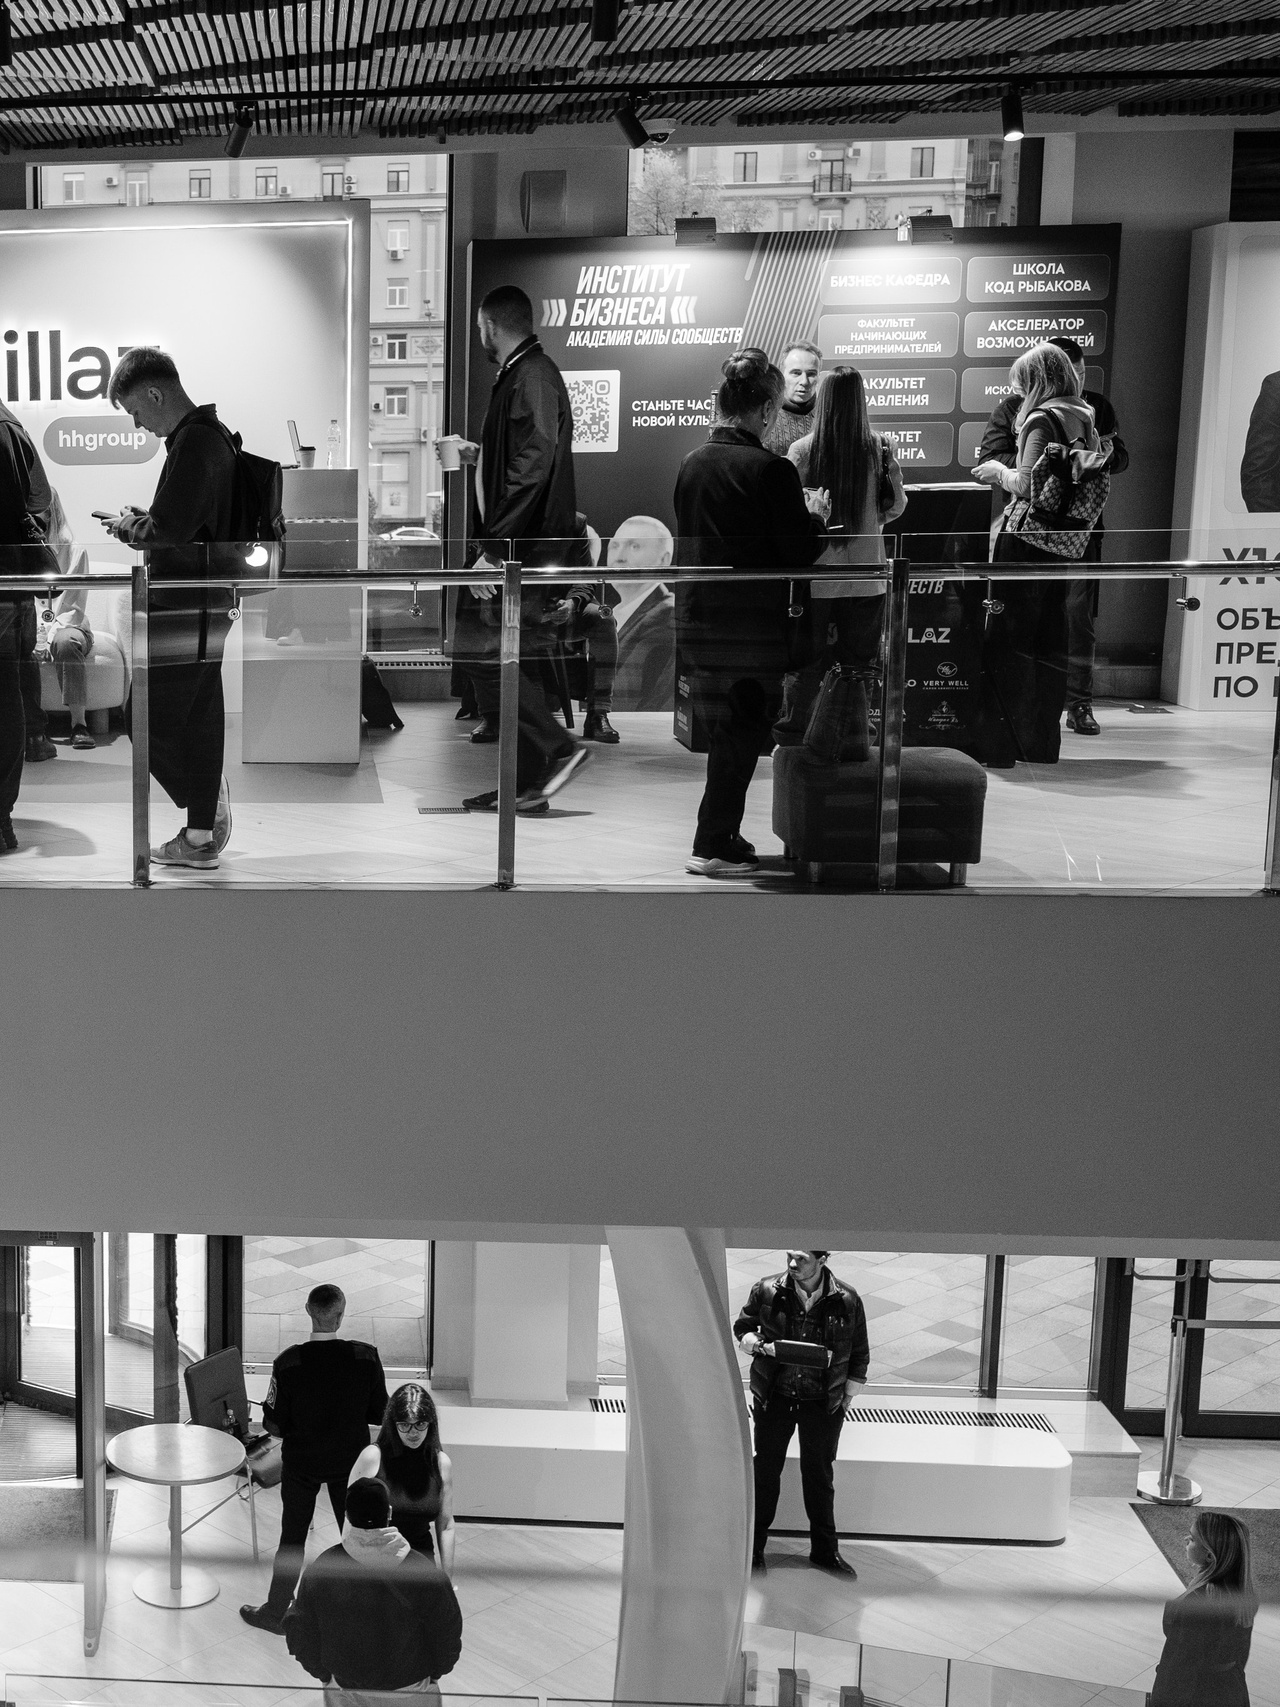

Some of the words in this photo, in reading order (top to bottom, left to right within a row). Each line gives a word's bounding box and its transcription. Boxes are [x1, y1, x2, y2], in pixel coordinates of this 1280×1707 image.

[1012, 263, 1065, 275] ШКОЛА
[576, 264, 690, 294] ИНСТИТУТ
[830, 275, 882, 287] БИЗНЕС
[885, 273, 950, 286] КАФЕДРА
[984, 281, 1014, 295] КОД
[1018, 280, 1091, 293] РЫБАКОВА
[570, 296, 666, 327] БИЗНЕСА
[857, 318, 916, 328] ФАКУЛЬТЕТ
[988, 318, 1085, 332] АКСЕЛЕРАТОР
[566, 330, 632, 348] АКАДЕМИЯ
[634, 329, 671, 346] СИЛЫ
[671, 327, 744, 346] СООБЩЕСТВ
[850, 330, 927, 341] НАЧИНАЮЩИХ
[977, 332, 1094, 349] ВОЗМОЖТЕЙ
[834, 341, 942, 355] ПРЕДПРИНИМАТЕЛЕЙ
[632, 400, 685, 411] СТАНЬТЕ
[632, 412, 677, 426] НОВОЙ
[678, 415, 711, 426] КУЛЬ
[58, 429, 148, 452] hhgroup
[1215, 642, 1280, 667] ПРЕ
[1213, 676, 1259, 698] ПО
